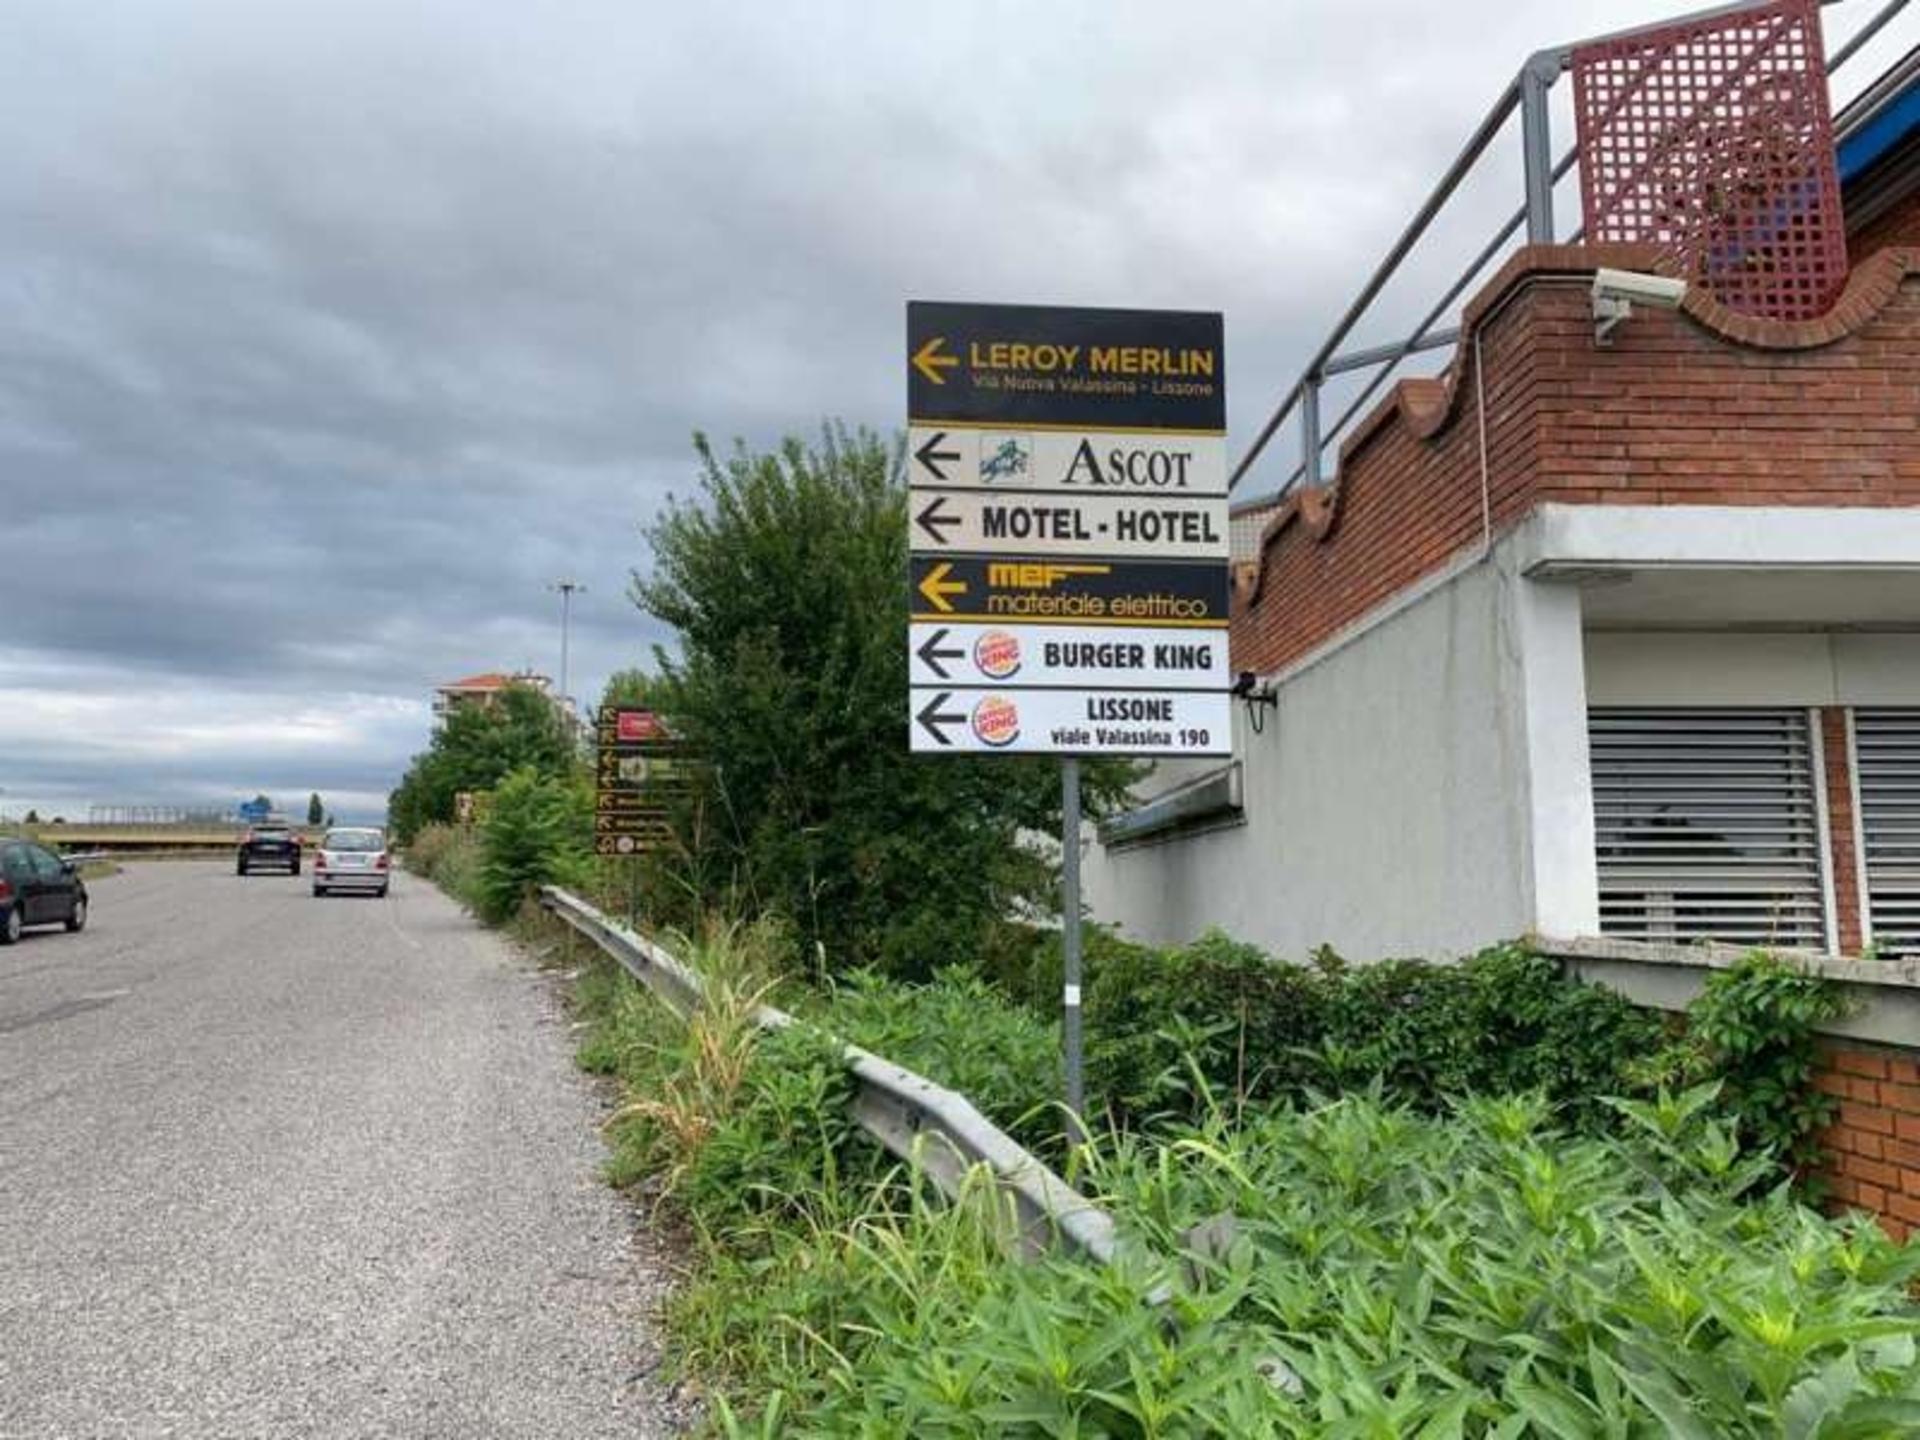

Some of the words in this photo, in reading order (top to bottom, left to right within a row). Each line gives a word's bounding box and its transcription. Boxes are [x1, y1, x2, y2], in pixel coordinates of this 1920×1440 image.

[970, 342, 1080, 371] LEROY
[1090, 347, 1214, 376] MERLIN
[972, 373, 999, 388] Via
[1152, 382, 1214, 397] Lissone
[1061, 437, 1192, 487] ASCOT
[982, 506, 1091, 540] MOTEL
[1116, 511, 1219, 543] HOTEL
[988, 591, 1105, 616] materiale
[1110, 594, 1208, 617] elettrico
[1044, 642, 1145, 669] BURGER
[1154, 645, 1212, 670] KING
[1087, 696, 1173, 721] LISSONE
[1051, 727, 1090, 745] viale
[1096, 729, 1172, 746] Valassina
[1179, 729, 1210, 746] 190
